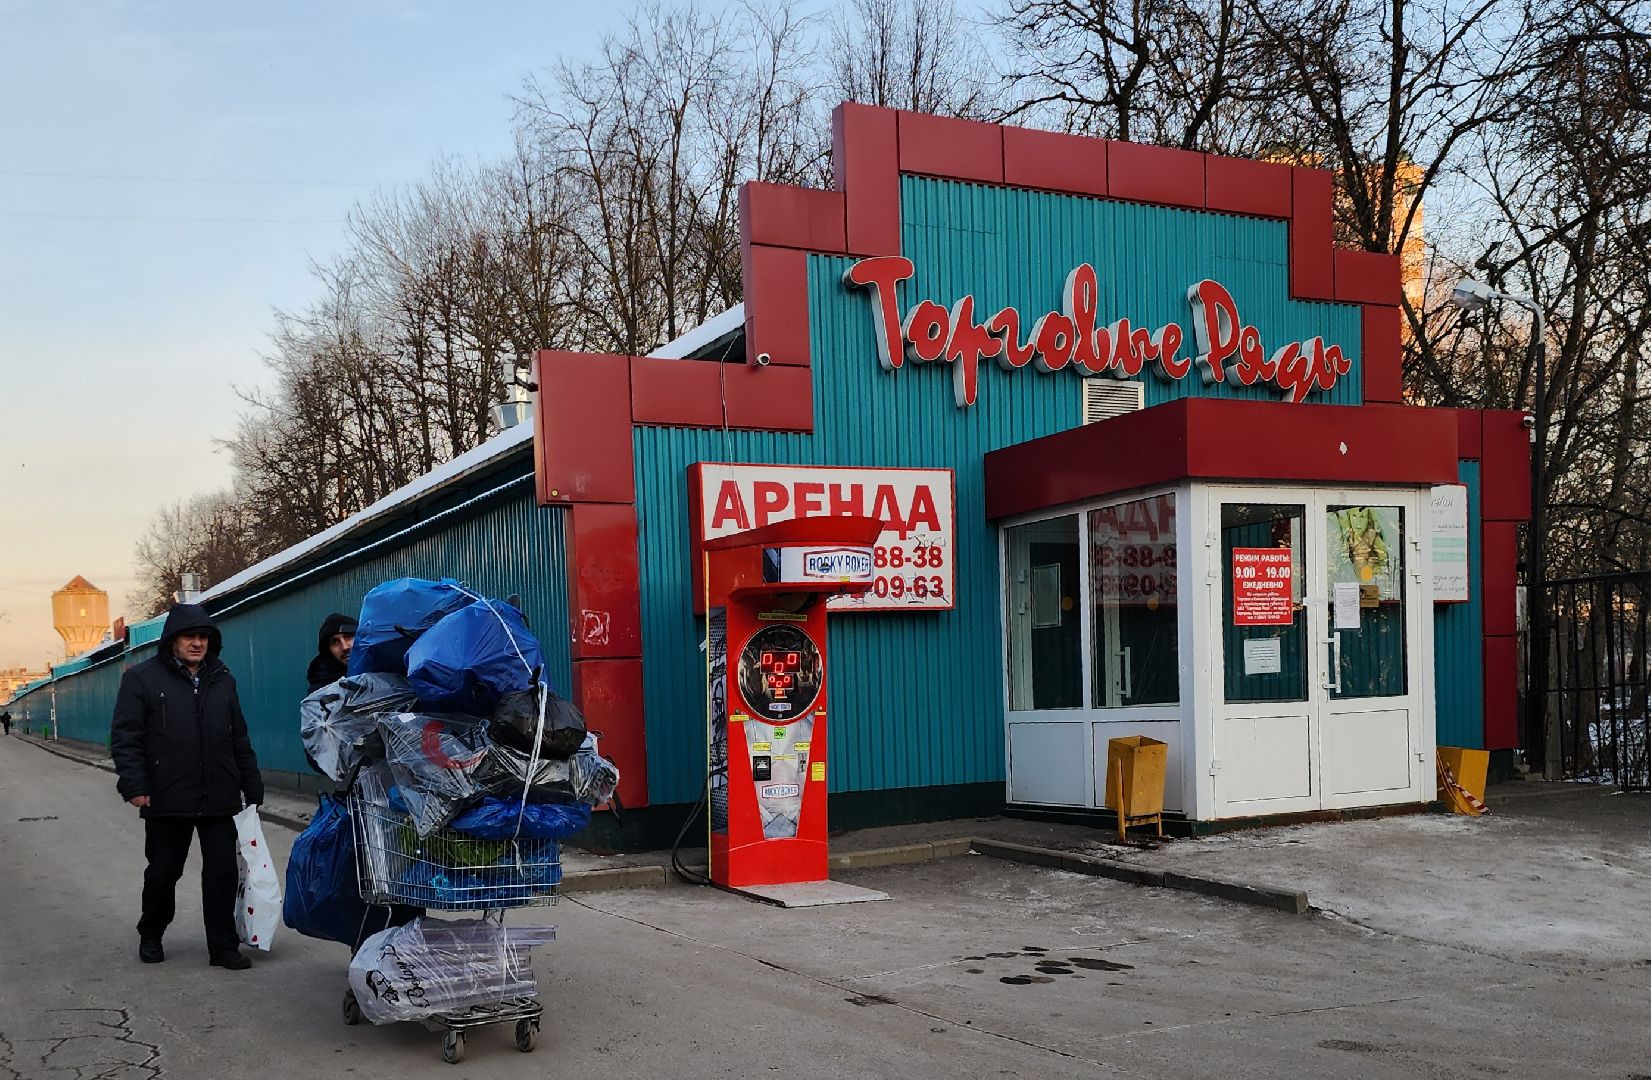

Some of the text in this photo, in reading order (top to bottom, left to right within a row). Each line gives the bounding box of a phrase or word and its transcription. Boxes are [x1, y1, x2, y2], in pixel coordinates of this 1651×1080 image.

[842, 254, 1352, 407] Торговые Ряды
[711, 479, 942, 540] АРЕНДА
[809, 555, 869, 574] ROCKY BOXER
[1235, 554, 1291, 563] РЕЖИМ РАБОТЫ:
[1235, 566, 1256, 579] 9.00
[1266, 566, 1291, 579] 19.00
[1242, 581, 1284, 591] ЕЖЕДНЕВНО
